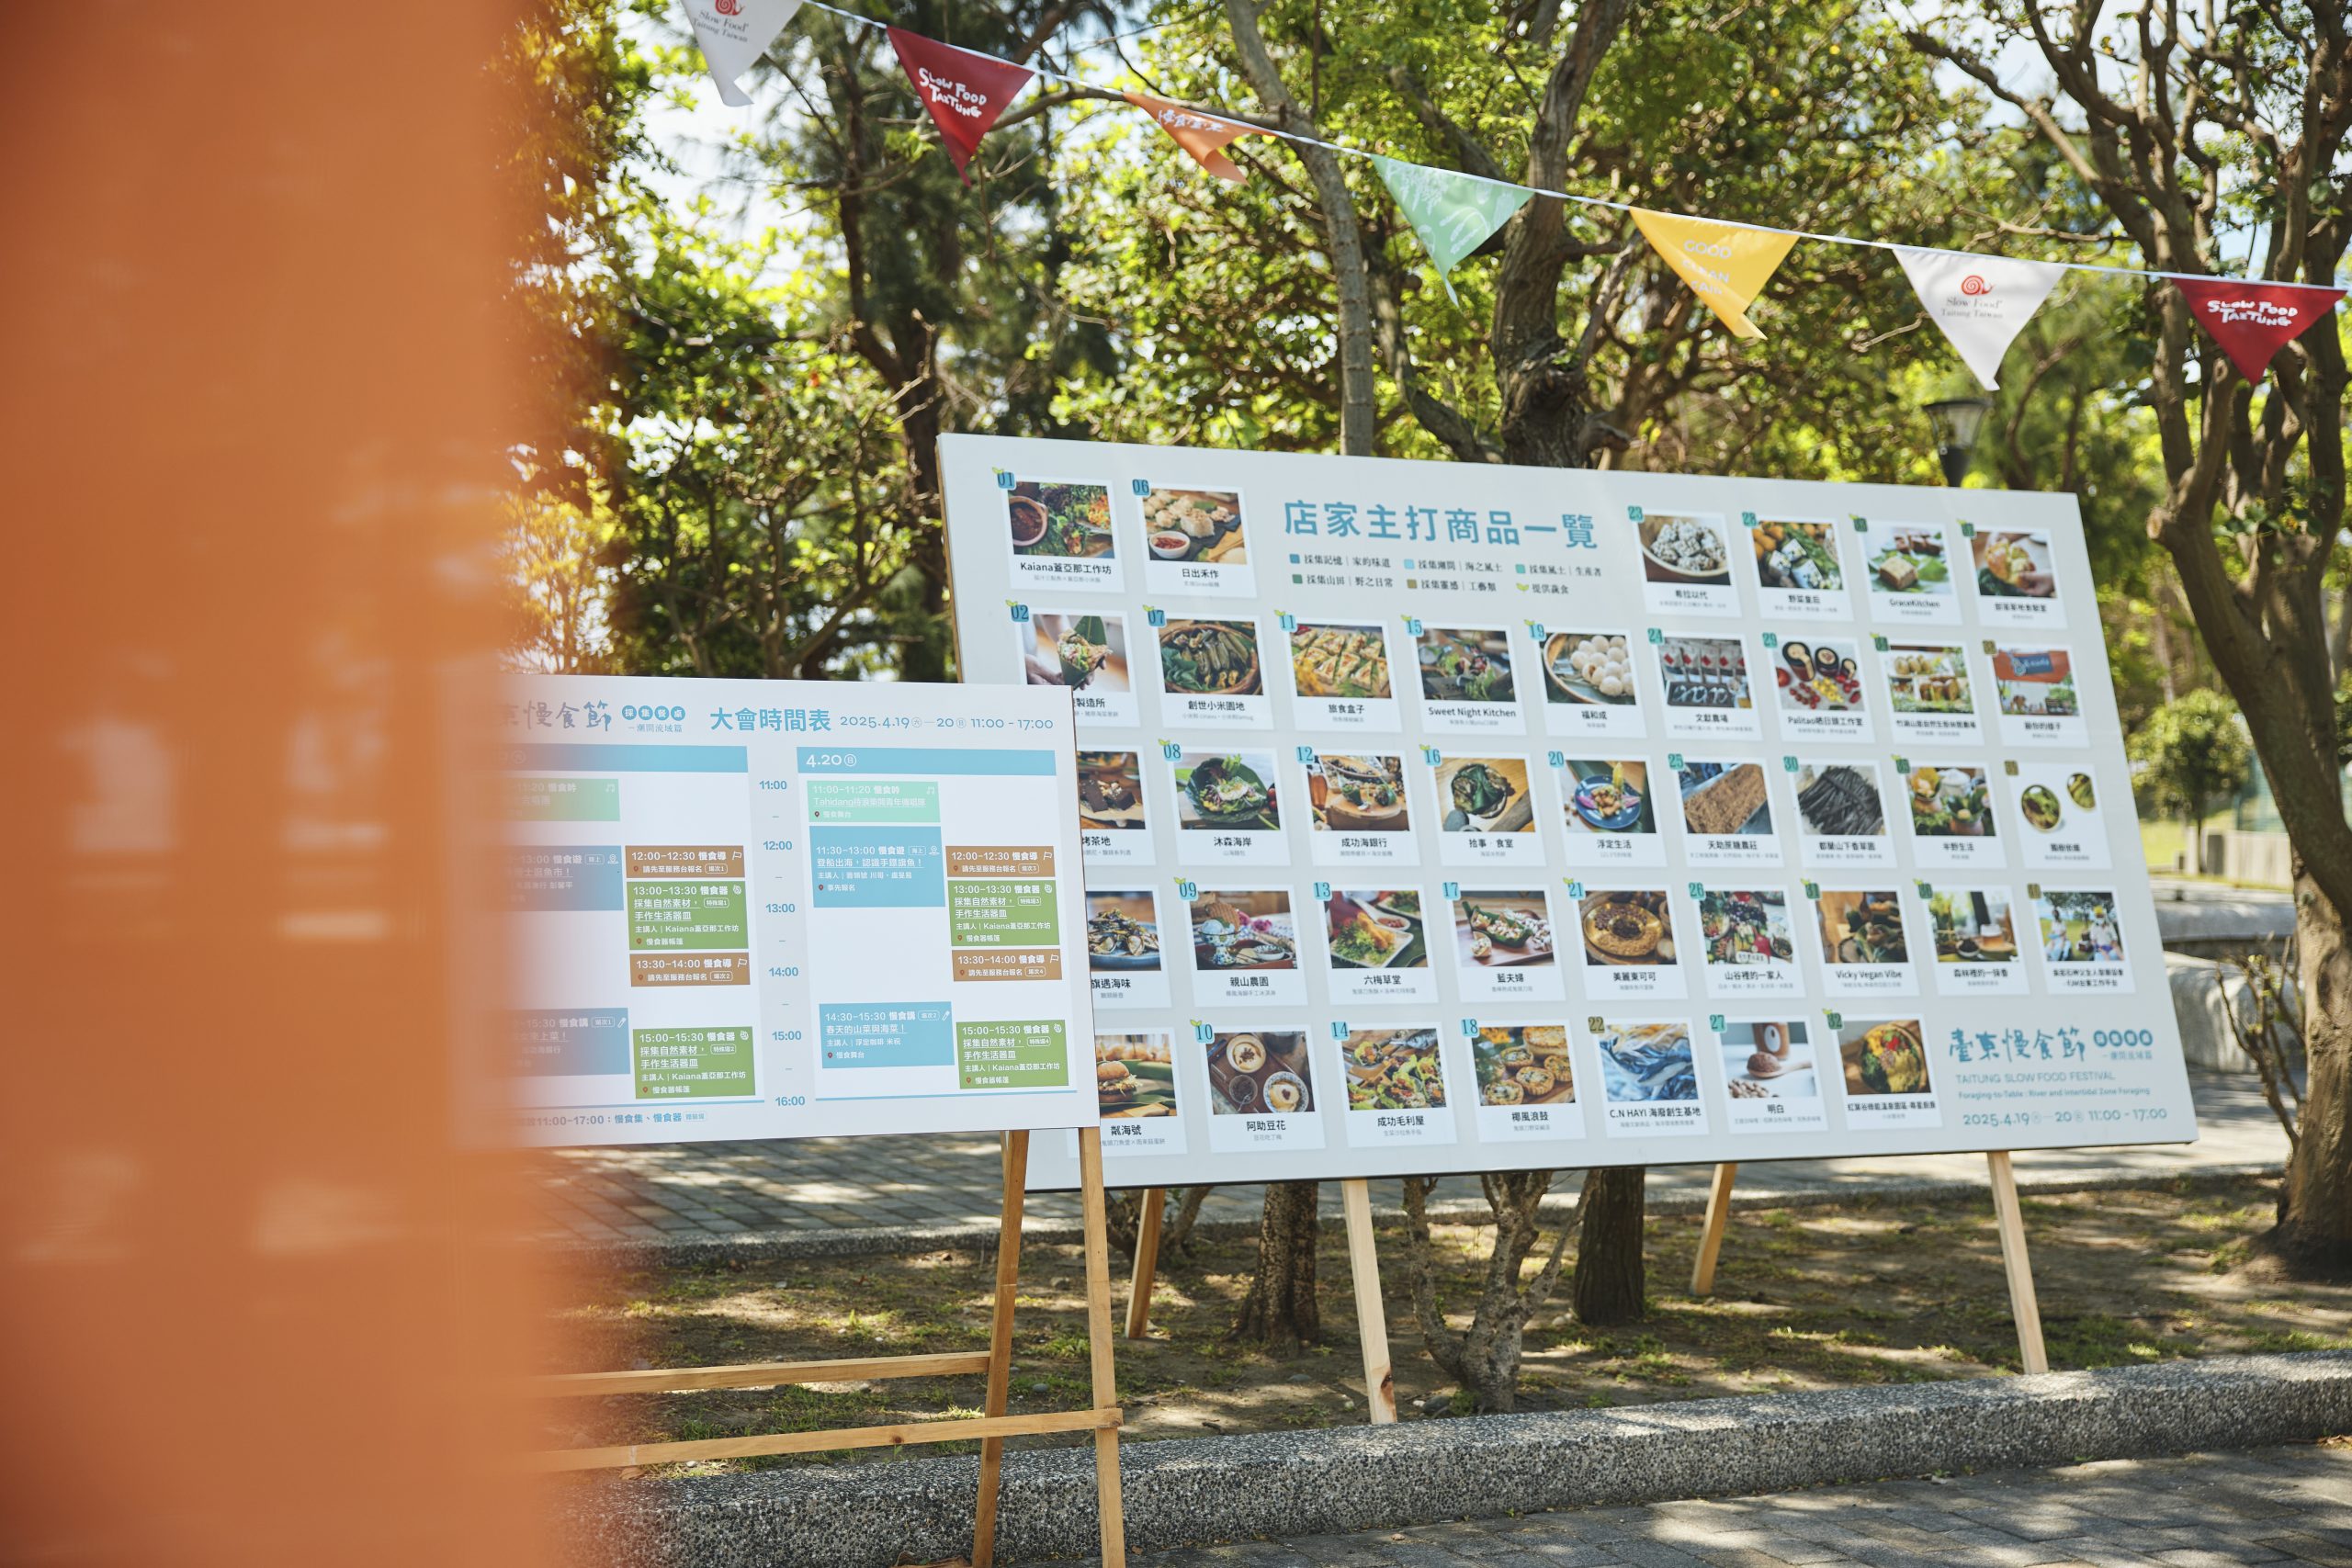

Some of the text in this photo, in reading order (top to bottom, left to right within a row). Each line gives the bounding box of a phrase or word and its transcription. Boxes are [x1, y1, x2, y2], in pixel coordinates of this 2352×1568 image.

[1684, 240, 1731, 259] GOOD
[1133, 479, 1149, 494] 06
[1284, 500, 1598, 549] 店家主打商品一覽
[1182, 568, 1219, 579] 日出禾作
[1012, 605, 1029, 620] 02
[1148, 609, 1165, 625] 07
[1530, 624, 1544, 637] 19
[1074, 698, 1105, 708] 製造所
[1429, 707, 1516, 719] Sweet Night Kitchen
[710, 707, 831, 732] 大會時間表
[971, 718, 1053, 730] 11:00 17:00
[1164, 744, 1181, 759] 08
[1297, 747, 1312, 761] 12
[1425, 750, 1441, 763] 16
[1549, 752, 1563, 766] 20
[759, 780, 787, 790] 11:00
[763, 841, 792, 851] 12:00
[1214, 836, 1252, 846] 沐森海岸
[1341, 838, 1387, 848] 成功海銀行
[632, 851, 695, 861] 12:00-12:30
[816, 846, 875, 855] 11:30-13:00
[951, 852, 1009, 860] 12:00-12:30
[633, 886, 697, 896] 13:00-13:30
[954, 885, 1011, 894] 13:00-13:30
[1180, 882, 1197, 897] 09
[1315, 883, 1331, 897] 13
[1444, 883, 1459, 897] 17
[1568, 883, 1583, 897] 21
[766, 903, 795, 913] 13:00
[955, 909, 1007, 918] 手作生活器皿
[634, 911, 691, 920] 手作生活器皿
[636, 959, 700, 969] 13:30-14:00
[958, 955, 1016, 964] 13:30-14:00
[769, 967, 798, 976] 14:00
[1836, 970, 1902, 980] Vicky Vegan Vibe
[826, 1012, 886, 1021] 14:30-15:30
[1711, 1015, 1725, 1029] 27
[963, 1026, 1020, 1035] 15:00-15:30
[1196, 1024, 1213, 1040] 10
[1332, 1022, 1348, 1037] 14
[1463, 1020, 1478, 1033] 18
[639, 1033, 703, 1043] 15:00-15:30
[772, 1031, 802, 1041] 15:00
[1950, 1025, 2085, 1062] 臺東慢食節
[964, 1050, 1016, 1060] 手作生活器皿
[641, 1058, 699, 1068] 手作生活器皿
[1956, 1071, 2115, 1084] TAITUNG SLOW FOOD FESTIVAL
[775, 1096, 805, 1106] 16:00
[1627, 1108, 1647, 1117] HAYI
[1767, 1104, 1784, 1114] 明白
[2089, 1108, 2167, 1122] 11:00 17:00
[1246, 1120, 1286, 1131] 阿助豆花
[1378, 1116, 1425, 1127] 成功毛利屋
